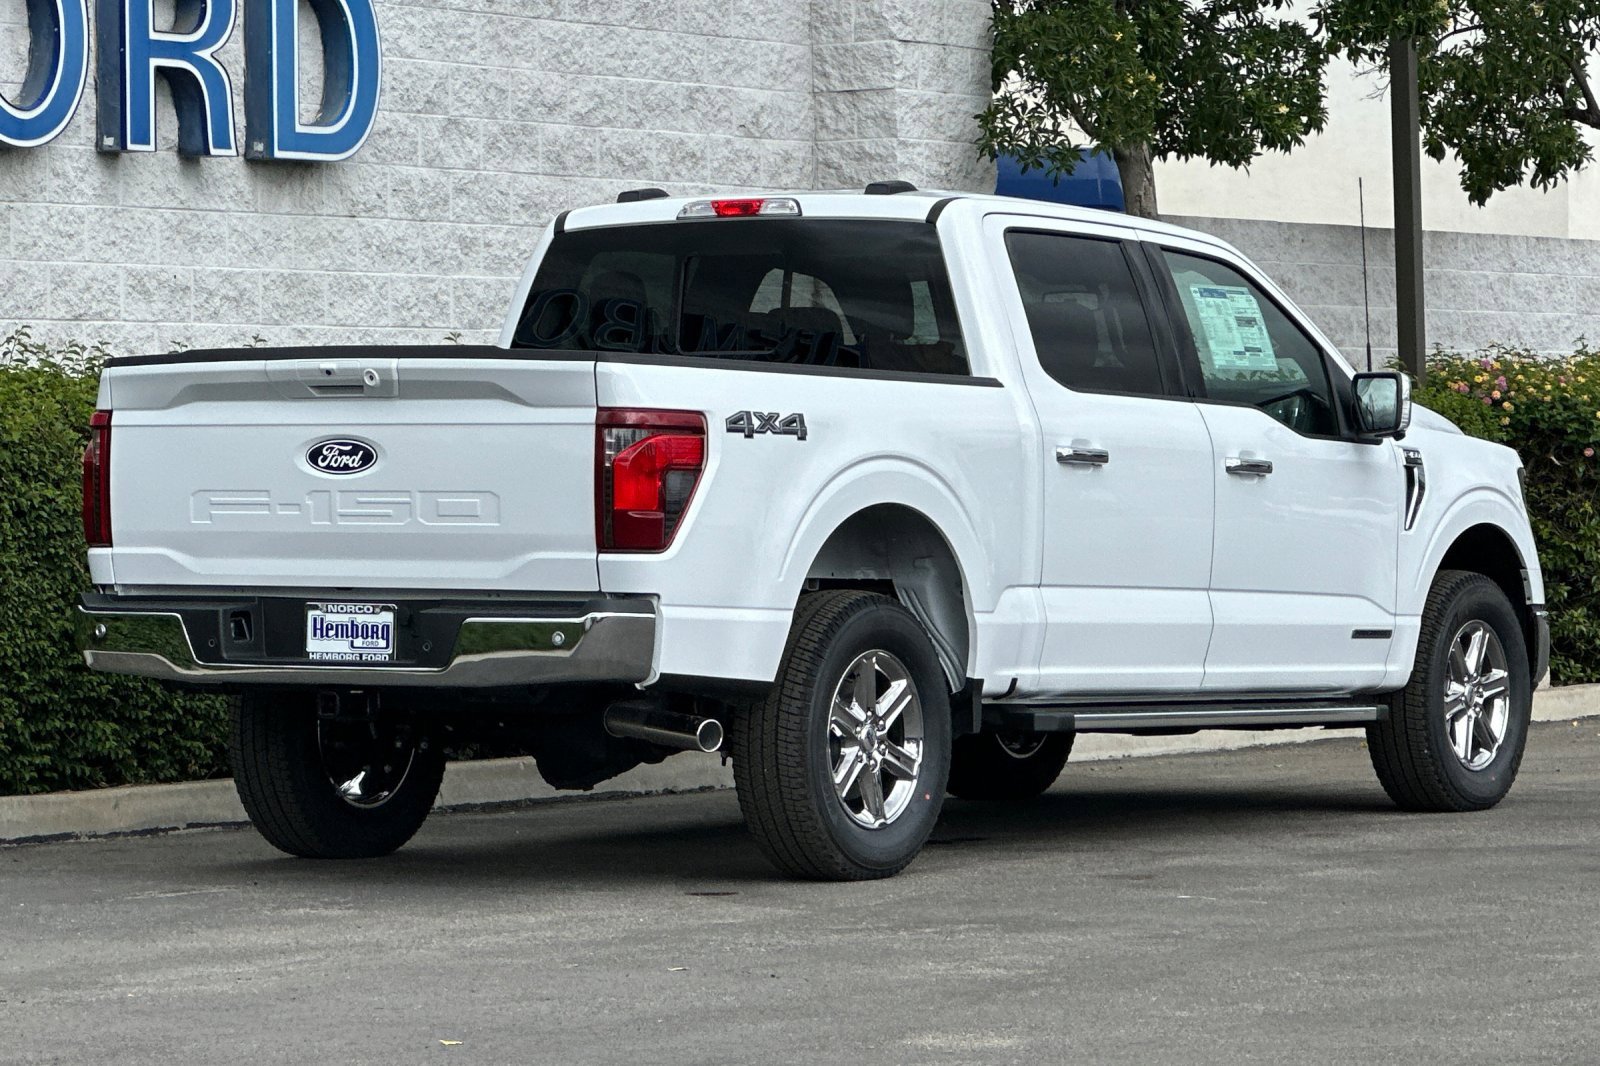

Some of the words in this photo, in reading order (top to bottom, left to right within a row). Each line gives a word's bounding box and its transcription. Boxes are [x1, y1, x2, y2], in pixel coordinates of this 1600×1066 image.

[317, 443, 363, 468] Ford
[190, 489, 501, 526] F-150
[327, 604, 374, 614] NORCO
[309, 652, 360, 661] HEMBORG
[362, 653, 389, 662] FORD
